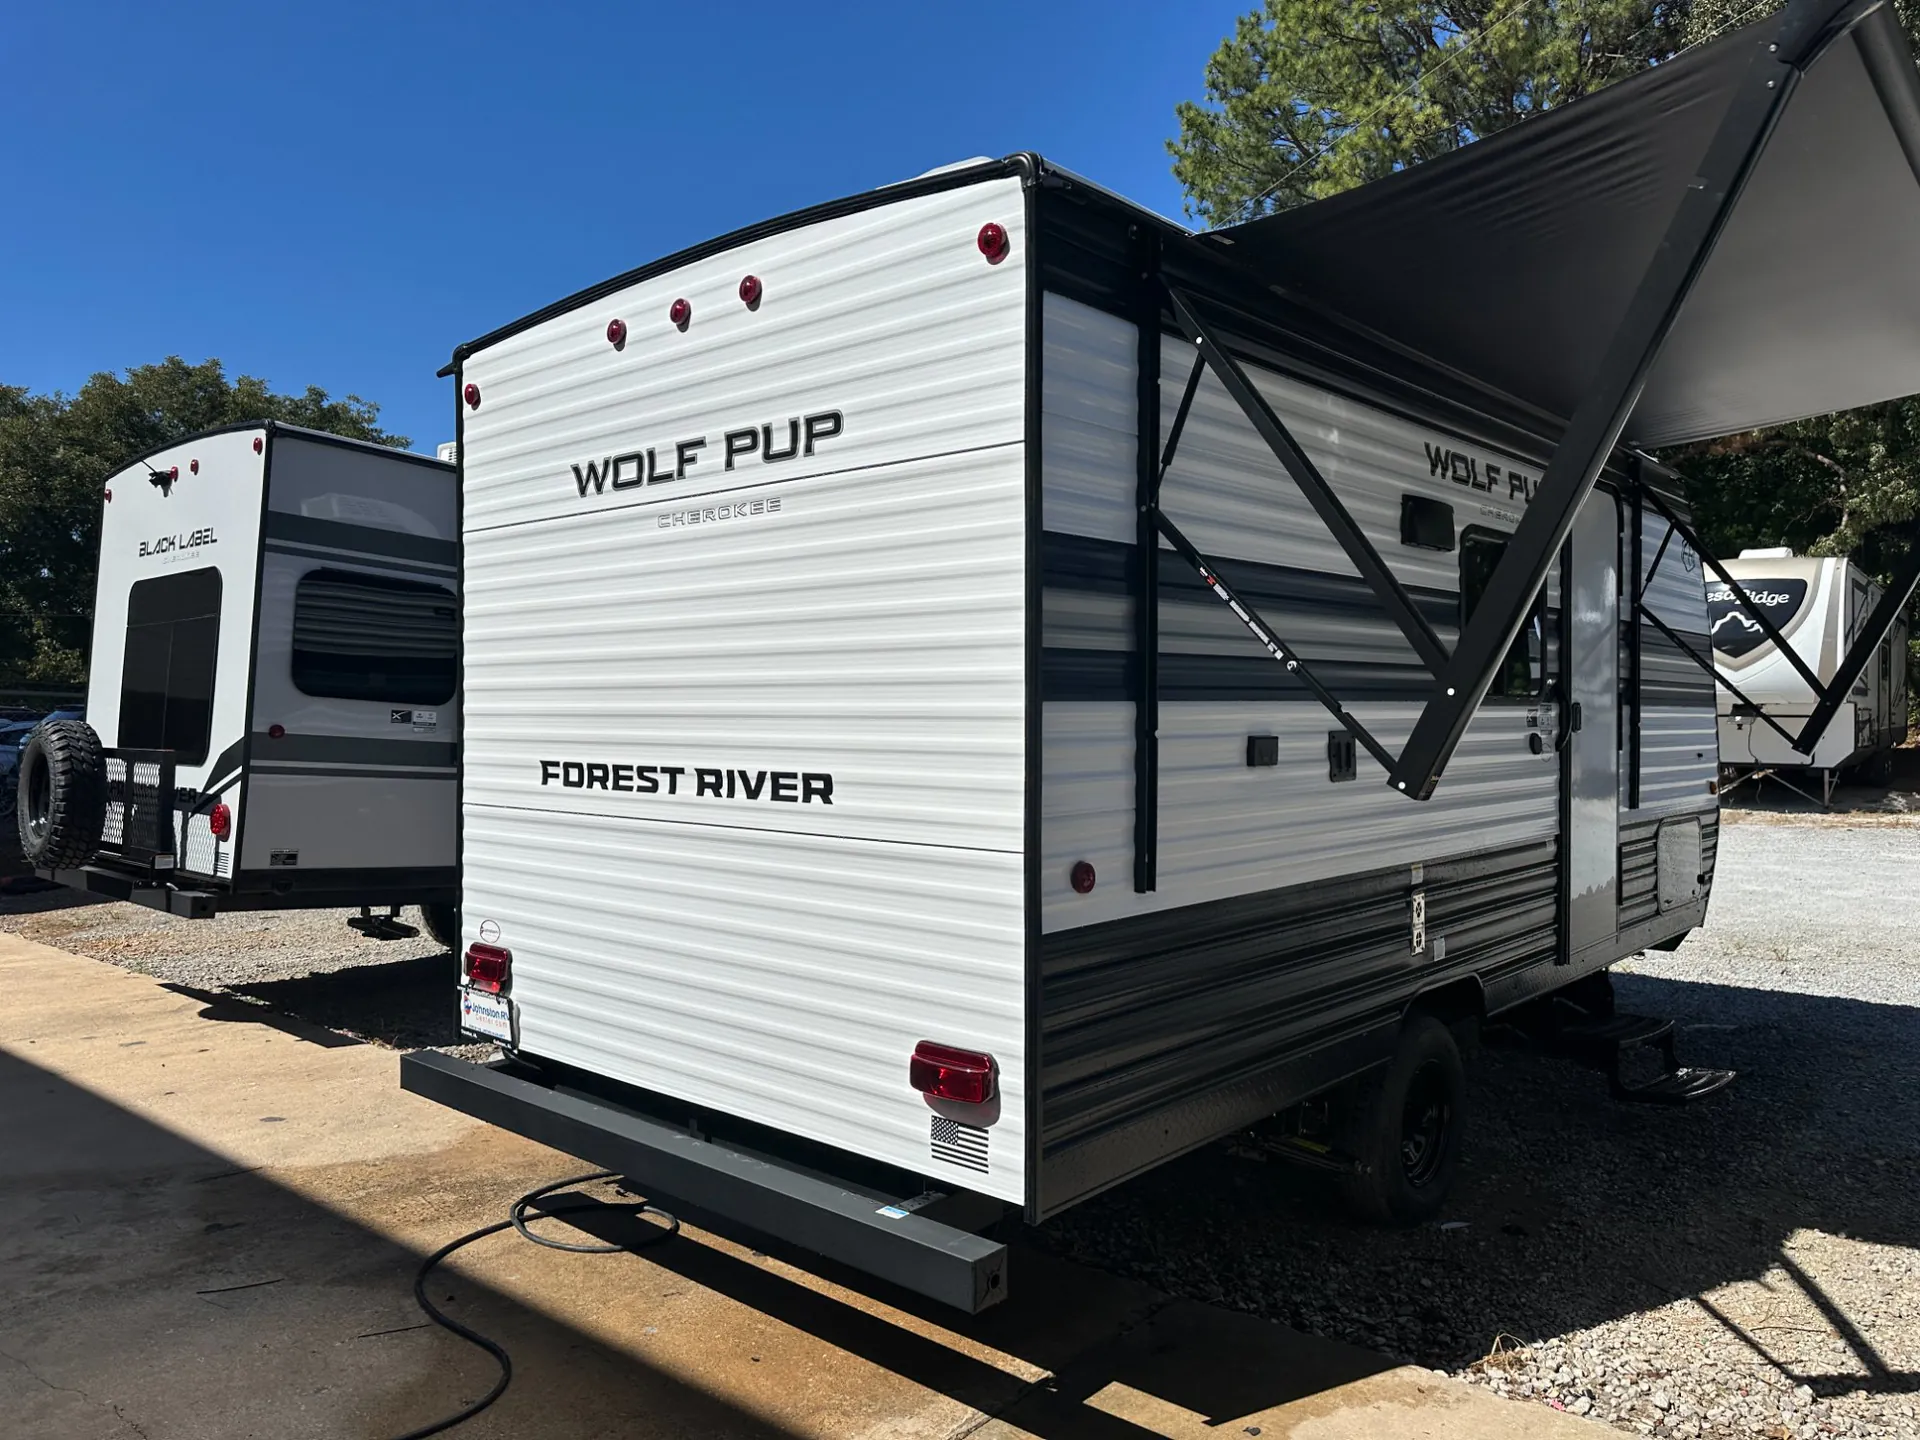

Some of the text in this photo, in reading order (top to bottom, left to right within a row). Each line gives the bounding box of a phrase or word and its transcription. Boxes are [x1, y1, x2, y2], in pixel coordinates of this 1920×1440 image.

[570, 409, 845, 498] WOLF PUP
[1424, 441, 1540, 504] WOLF PU
[657, 497, 782, 528] CHEROKEE
[138, 535, 177, 558] BLACK
[179, 527, 218, 550] LABEL
[1706, 591, 1737, 603] esa
[539, 760, 834, 805] FOREST RIVER
